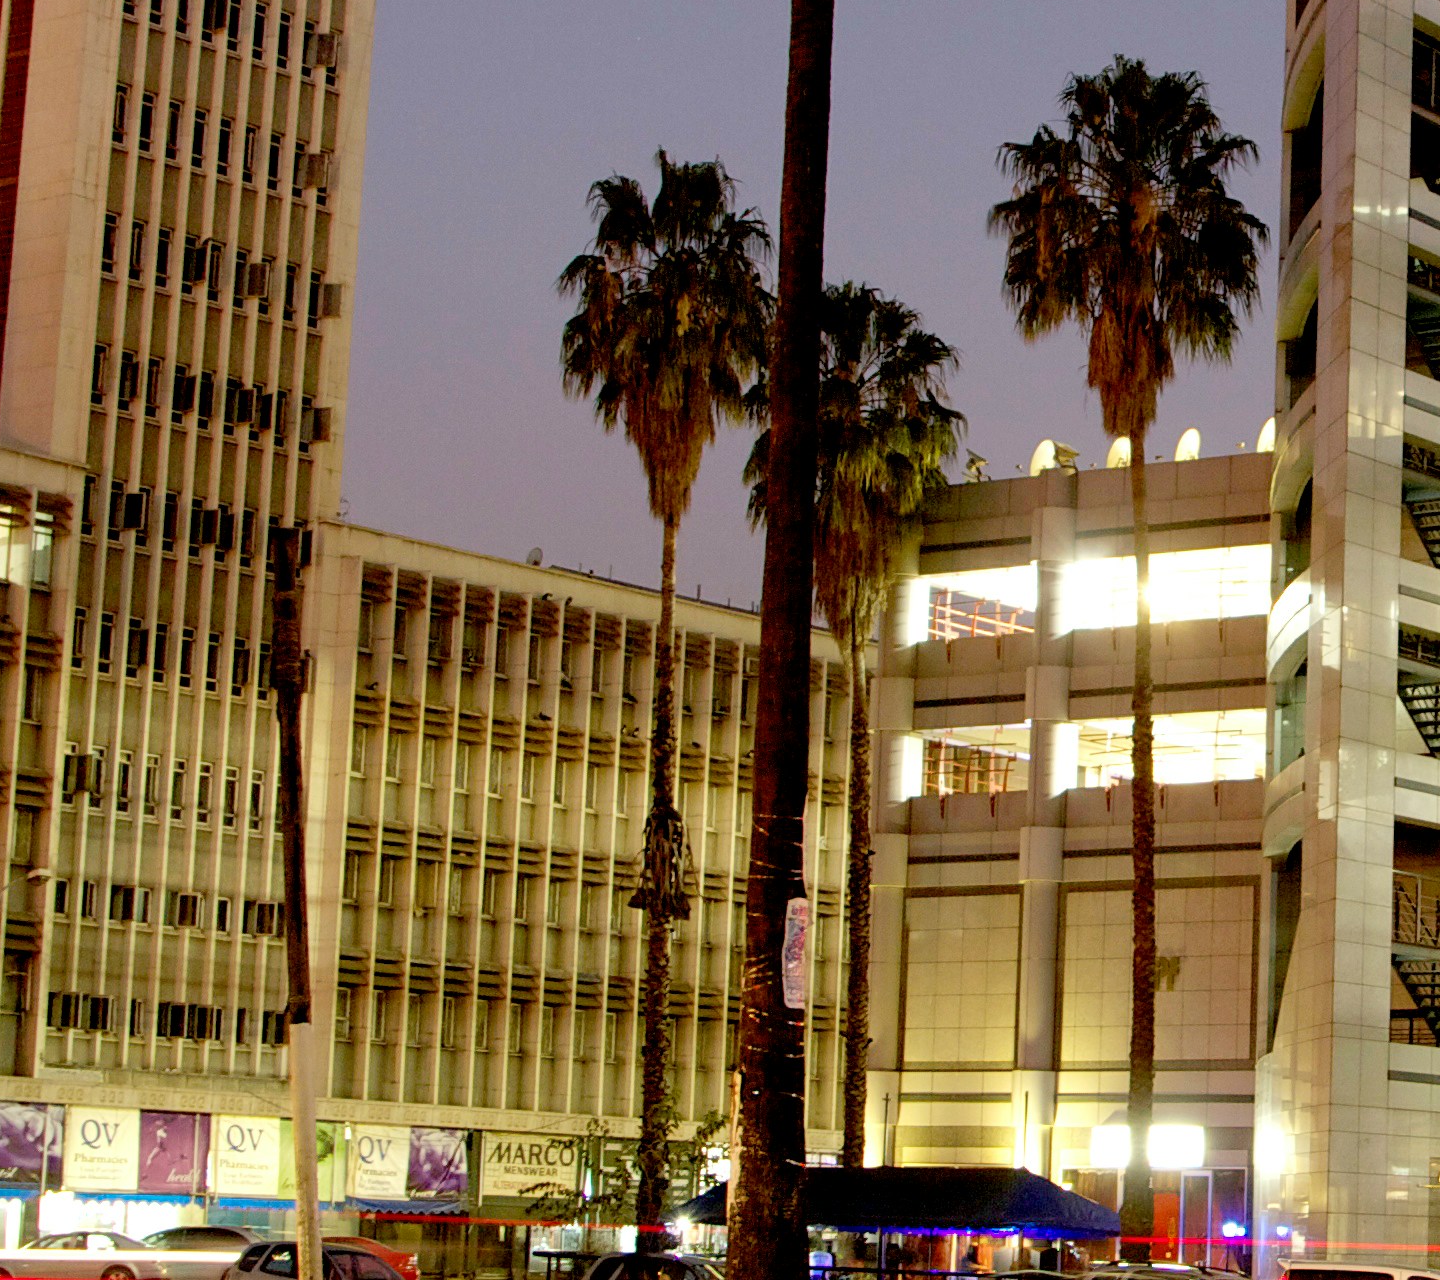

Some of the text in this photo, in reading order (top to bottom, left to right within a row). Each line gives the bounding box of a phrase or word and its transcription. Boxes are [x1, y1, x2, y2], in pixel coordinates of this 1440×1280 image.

[81, 1119, 120, 1149] QV
[226, 1124, 264, 1153] QV
[74, 1153, 128, 1163] Pharmacies
[358, 1135, 392, 1164] QV
[488, 1142, 575, 1167] MARCO
[219, 1158, 269, 1170] Pharmacies
[504, 1166, 558, 1177] MENSWEAR
